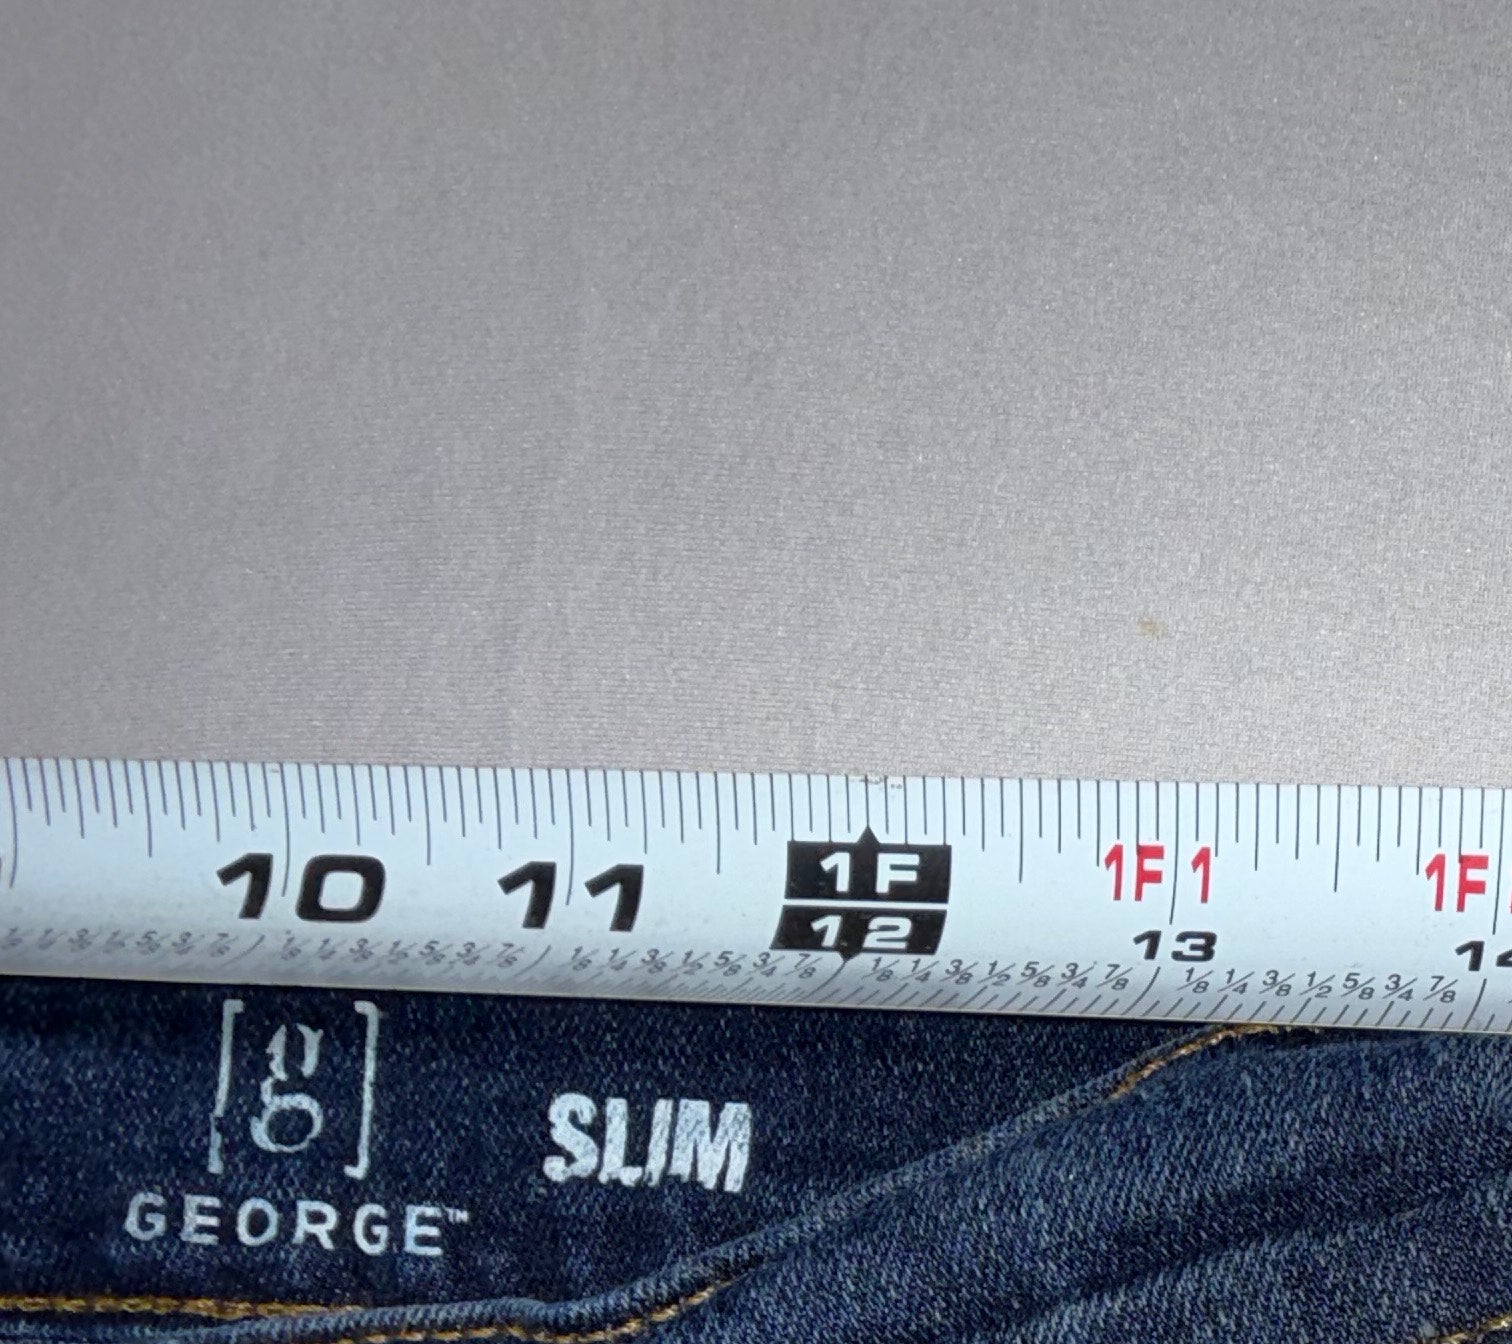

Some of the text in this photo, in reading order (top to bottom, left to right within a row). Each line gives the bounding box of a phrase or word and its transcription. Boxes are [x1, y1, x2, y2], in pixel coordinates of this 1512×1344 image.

[216, 852, 387, 923] 10
[497, 861, 645, 932] 11
[819, 852, 921, 894] 1F
[810, 914, 913, 950] 12
[1132, 930, 1218, 962] 13
[543, 1092, 753, 1193] SLIM
